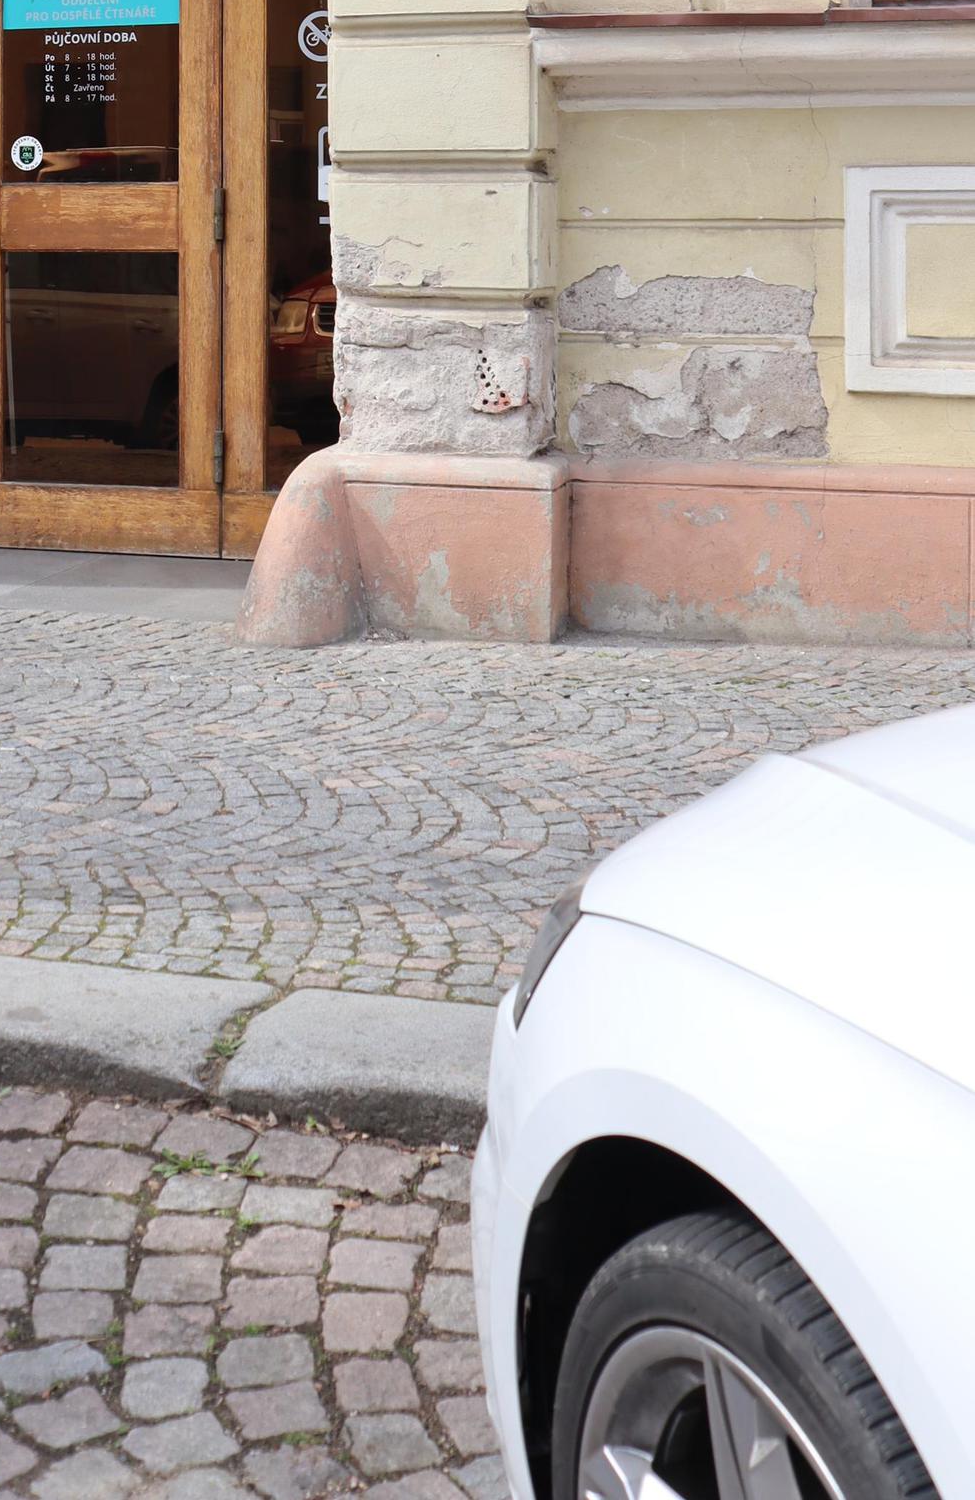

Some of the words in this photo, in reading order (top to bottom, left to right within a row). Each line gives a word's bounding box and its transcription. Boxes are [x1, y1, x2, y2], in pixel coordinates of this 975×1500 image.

[25, 11, 48, 21] PRO
[52, 7, 101, 20] DOSPĚLÉ
[105, 5, 156, 19] ČTENÁŘE
[45, 31, 102, 47] PŮJČOVNÍ
[104, 32, 137, 43] DOBA
[99, 52, 116, 60] hod.
[45, 63, 55, 72] Út
[99, 62, 116, 70] hod.
[45, 74, 53, 82] St
[65, 74, 70, 82] 8
[99, 73, 116, 81] hod.
[45, 84, 54, 92] Čt
[74, 83, 104, 92] Zavřeno
[45, 94, 55, 103] Pá
[65, 94, 70, 102] 8
[99, 93, 116, 101] hod.
